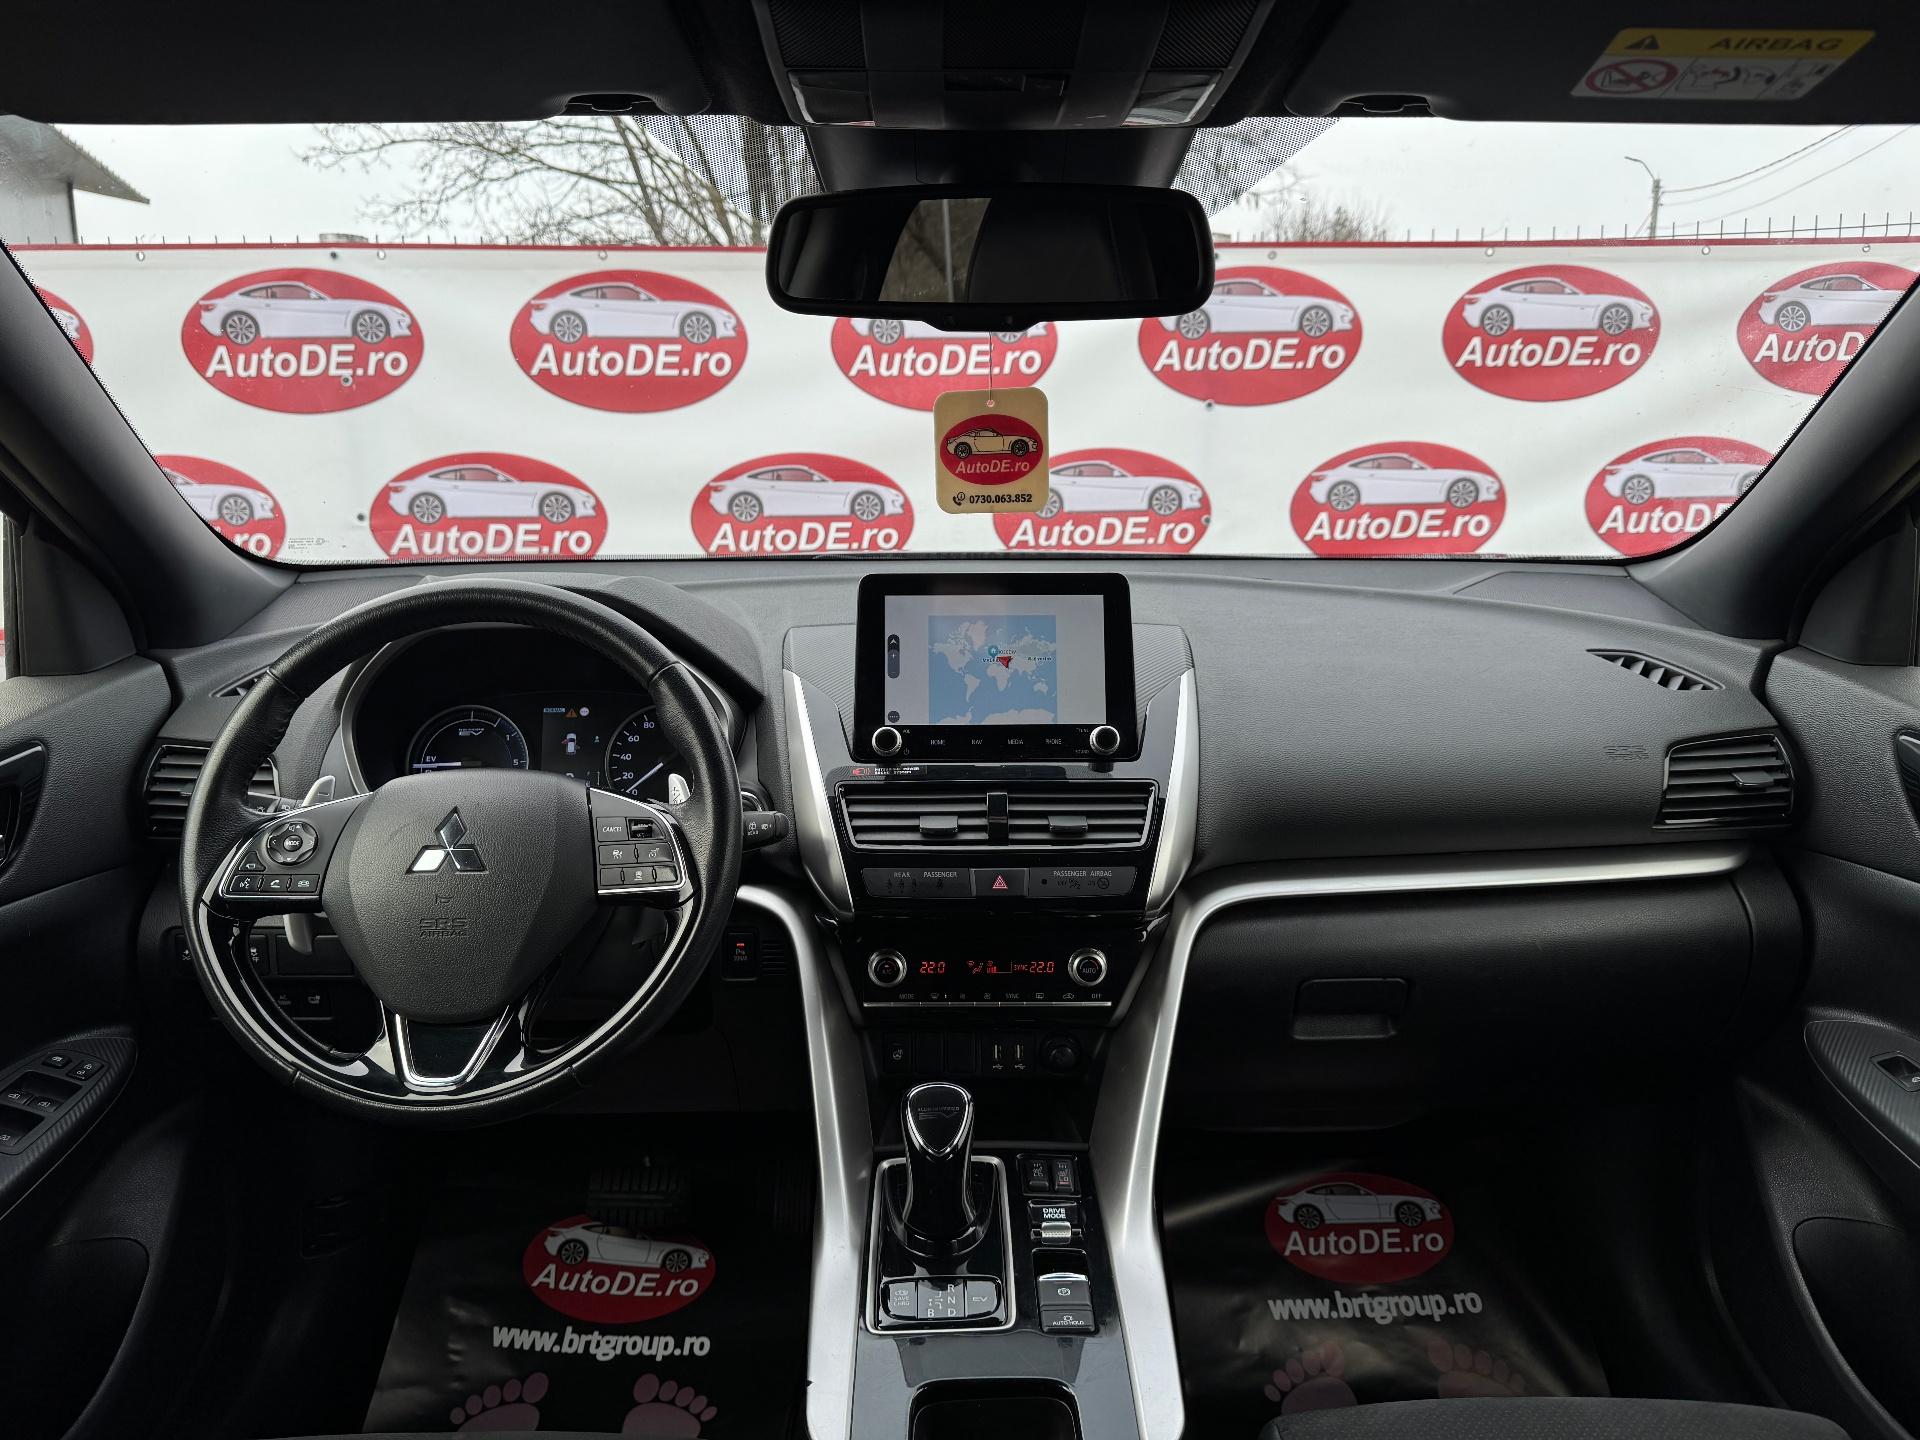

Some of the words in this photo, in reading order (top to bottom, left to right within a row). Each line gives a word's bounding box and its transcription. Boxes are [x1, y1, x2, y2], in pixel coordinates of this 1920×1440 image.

[1709, 37, 1844, 50] AIRBAG
[205, 343, 409, 379] AutoDE.ro
[530, 343, 733, 378] AutoDE.ro
[849, 343, 1042, 377] AutoDE.ro
[1153, 338, 1346, 372] AutoDE.ro
[1455, 335, 1641, 367] AutoDE.ro
[955, 459, 1030, 474] AutoDE.ro
[969, 493, 1033, 504] 0730.063.852
[390, 522, 594, 557] AutoDE.ro
[708, 521, 899, 553] AutoDE.ro
[1009, 516, 1195, 549] AutoDE.ro
[1304, 508, 1491, 541] AutoDE.ro
[643, 721, 655, 729] 80
[620, 753, 632, 761] 40
[622, 771, 634, 779] 20
[631, 788, 638, 796] 0
[1283, 1228, 1445, 1257] AutoDE.ro
[531, 1263, 699, 1297] AutoDE.ro
[947, 1284, 955, 1292] R
[927, 1308, 935, 1317] B
[947, 1296, 956, 1304] N
[947, 1308, 956, 1317] D
[1268, 1290, 1484, 1325] www.brtgroup.ro
[492, 1325, 711, 1361] www.brtgroup.ro
